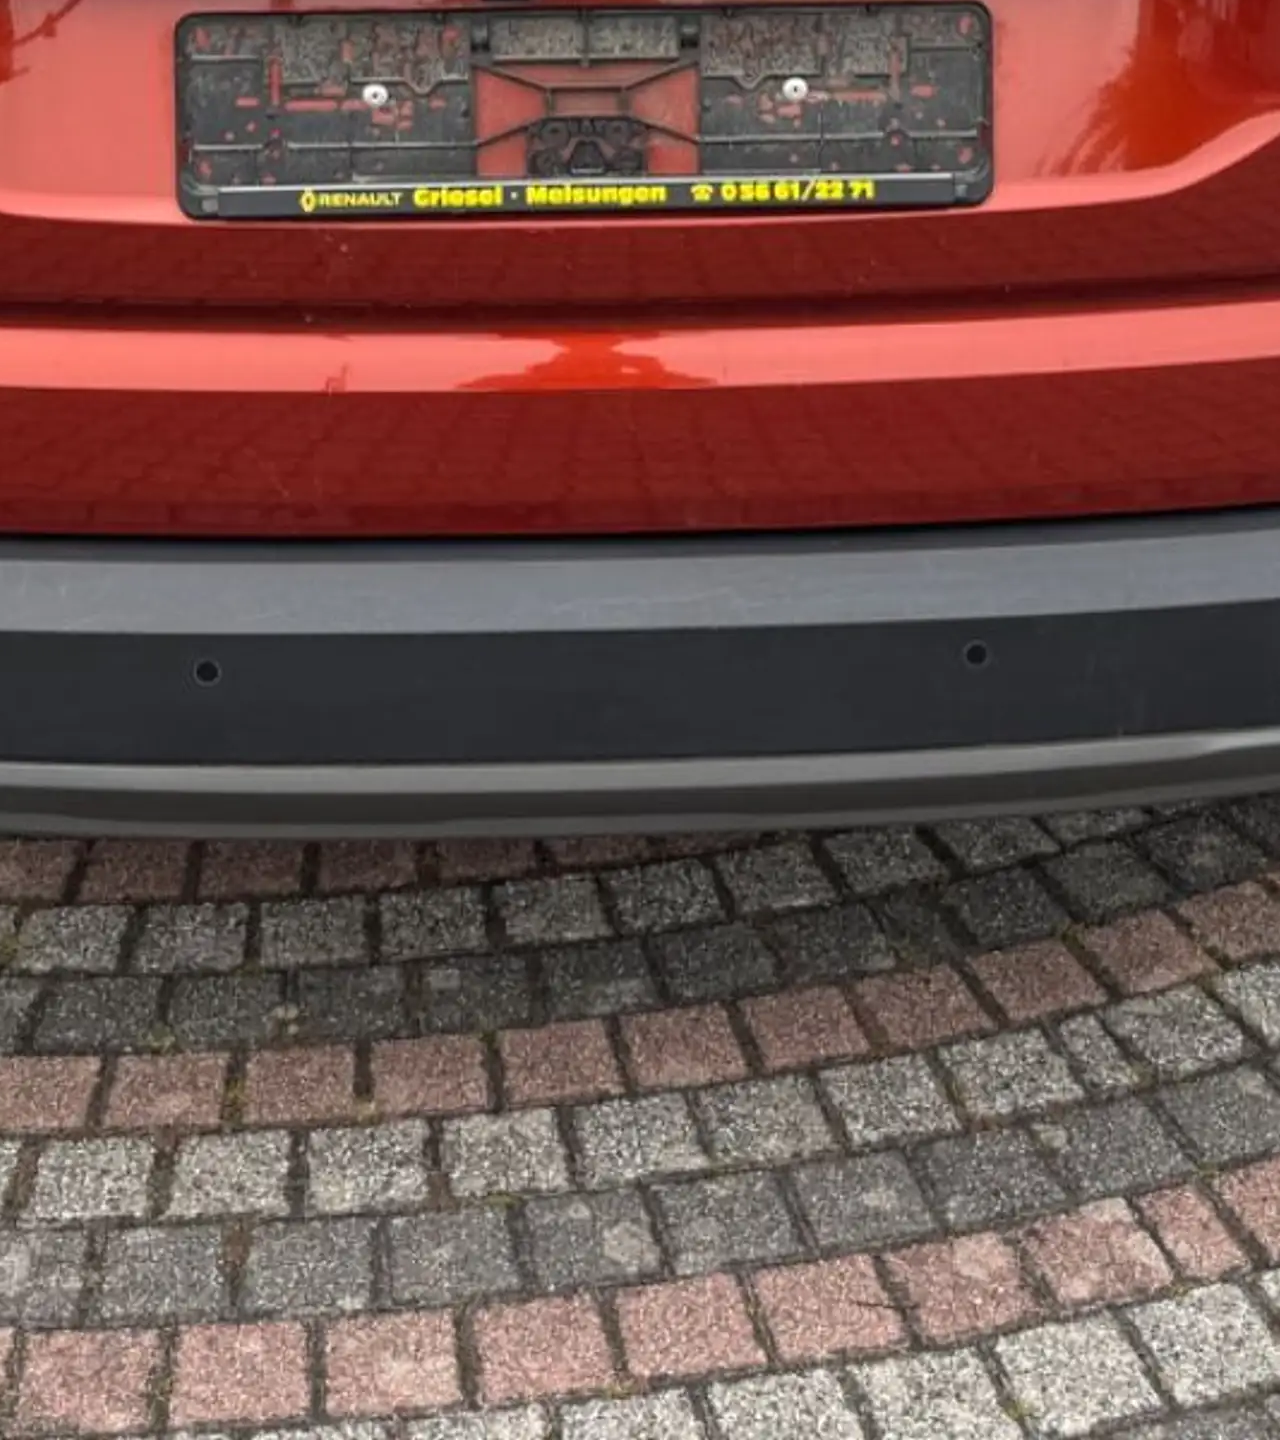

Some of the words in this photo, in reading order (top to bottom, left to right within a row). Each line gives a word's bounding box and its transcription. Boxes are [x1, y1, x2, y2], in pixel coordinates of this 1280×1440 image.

[319, 191, 402, 207] RENAULT
[413, 185, 503, 206] Griesel
[525, 182, 667, 205] Melsungen
